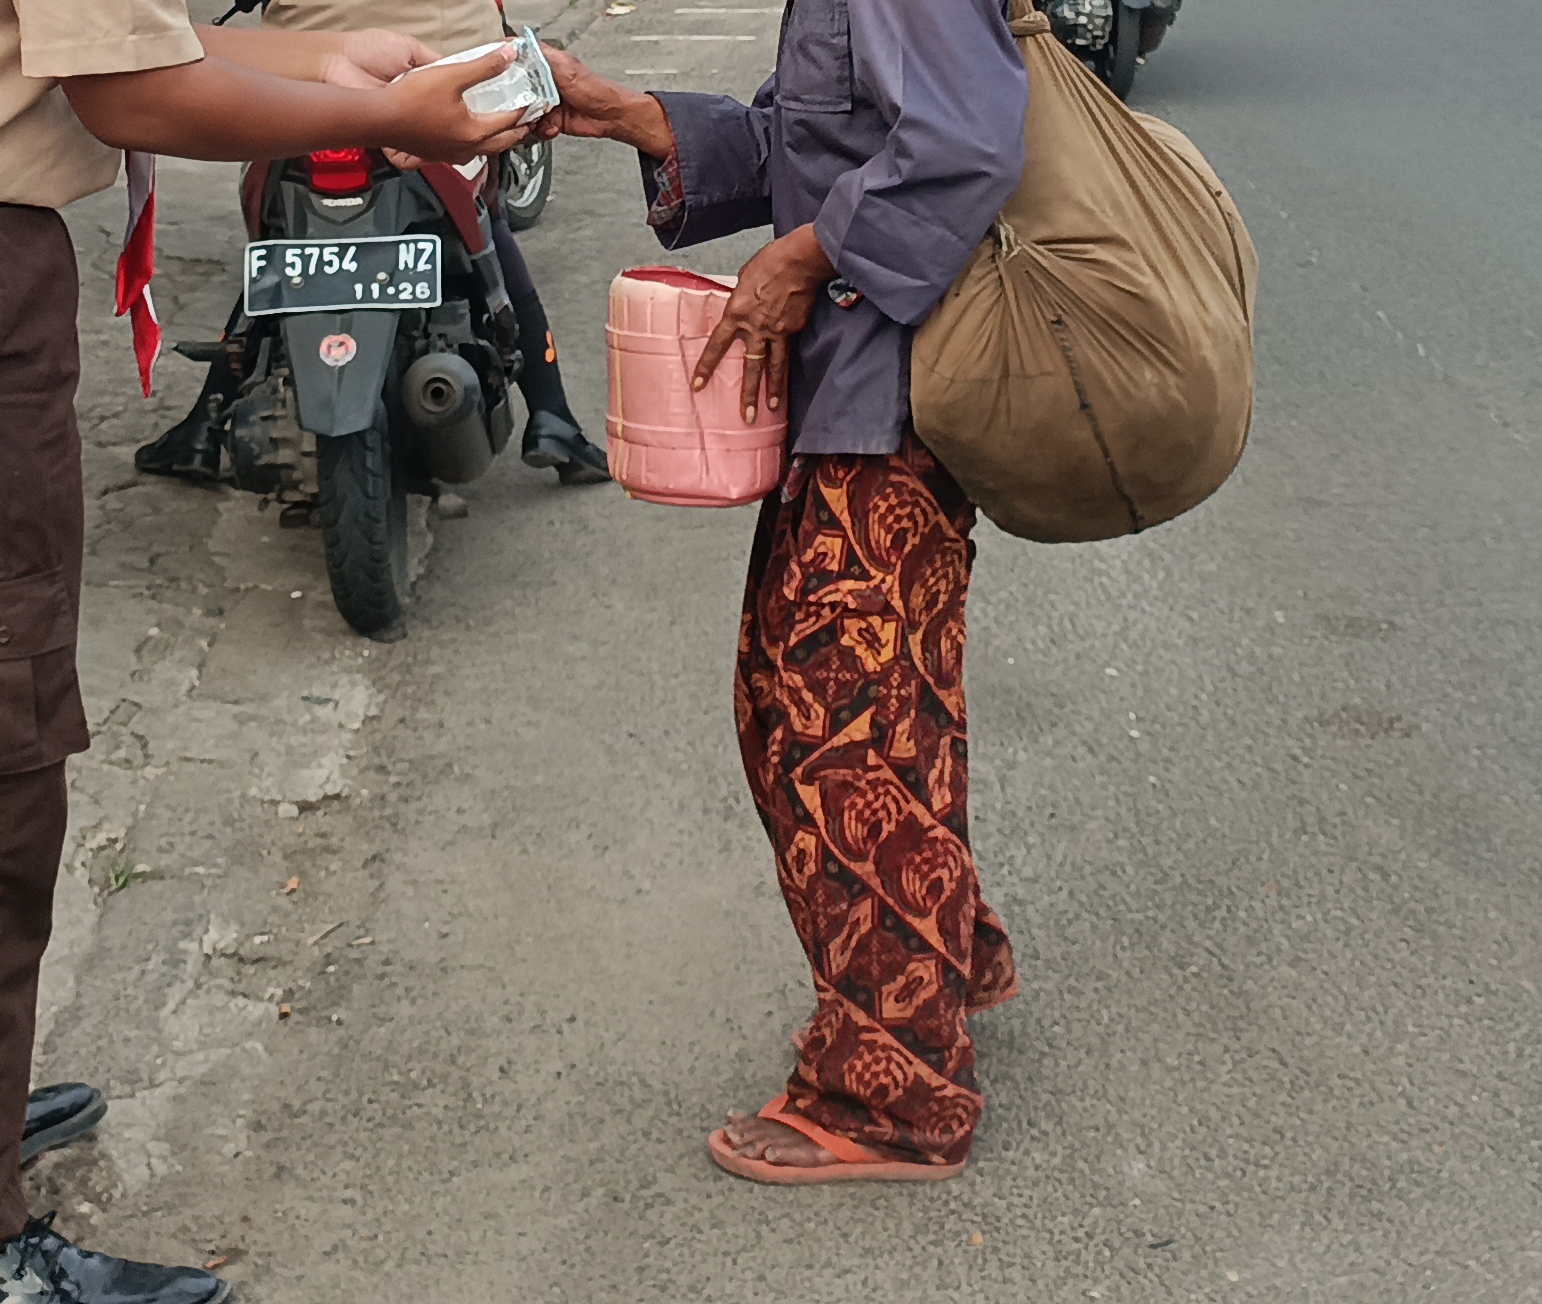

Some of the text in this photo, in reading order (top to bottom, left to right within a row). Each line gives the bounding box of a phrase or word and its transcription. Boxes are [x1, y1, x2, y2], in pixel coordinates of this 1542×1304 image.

[250, 241, 434, 279] F 5754 NZ
